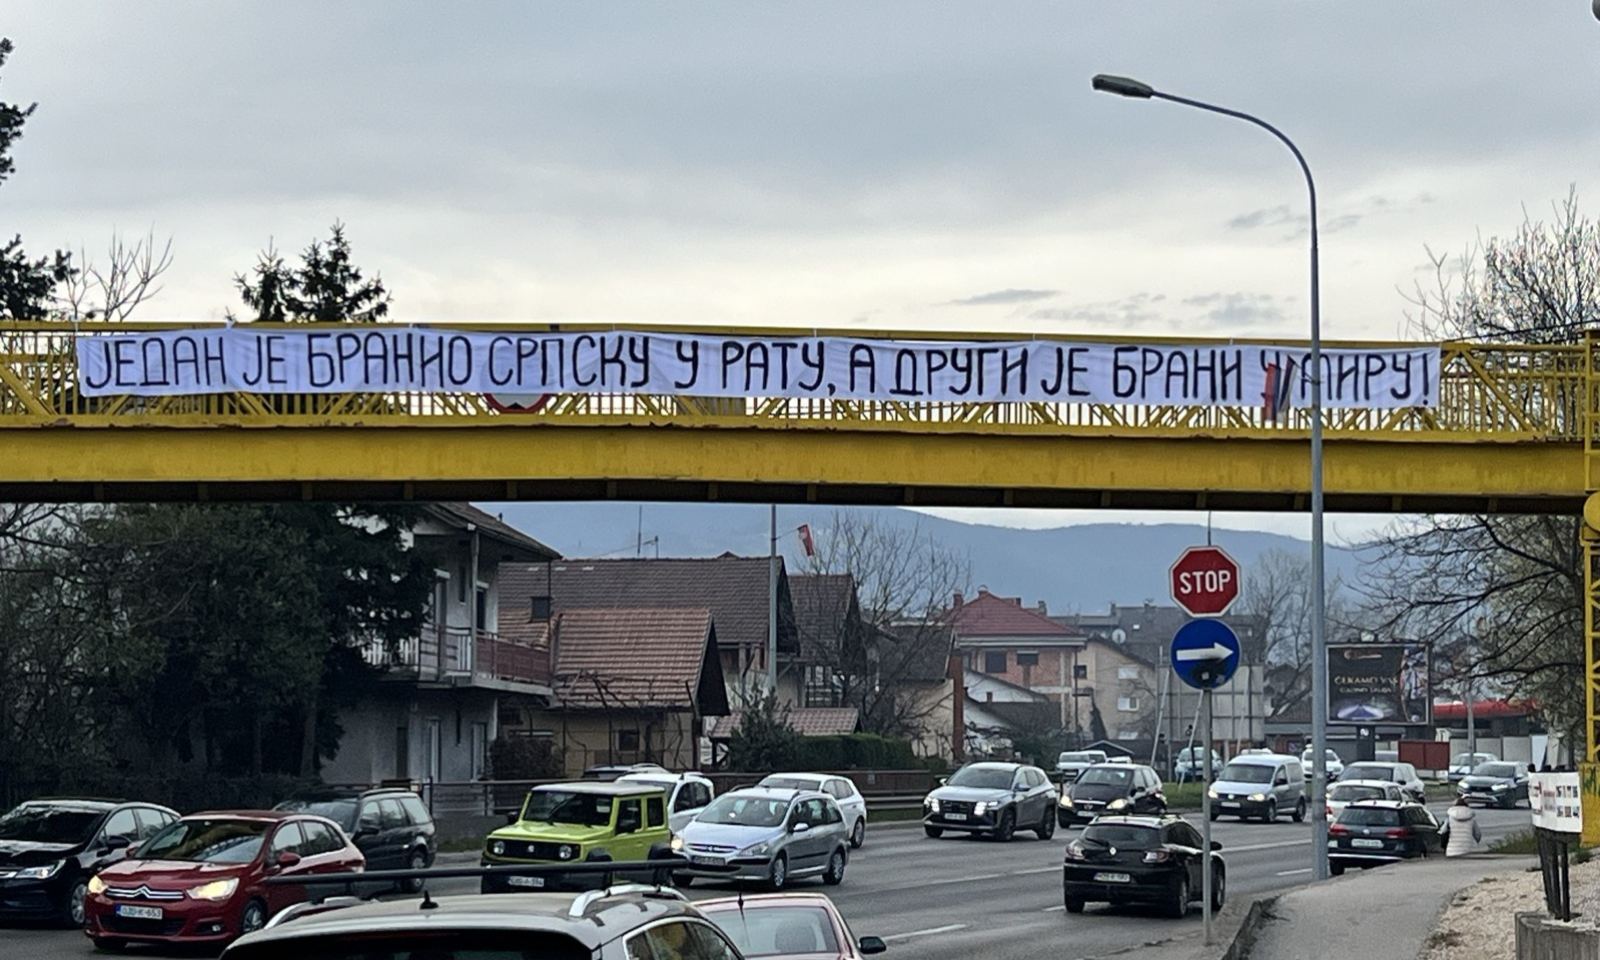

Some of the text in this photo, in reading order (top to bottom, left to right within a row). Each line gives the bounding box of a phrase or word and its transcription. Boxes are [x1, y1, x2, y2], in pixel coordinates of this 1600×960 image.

[85, 335, 227, 389] ЈЕДАН
[242, 335, 287, 386] ЈЕ
[307, 332, 473, 388] БРАНИО
[488, 335, 651, 389] СРПСКУ
[674, 340, 699, 389] У
[720, 340, 837, 397] РАТУ,
[849, 343, 876, 394] А
[889, 347, 1029, 396] ДРУГИ
[1040, 346, 1091, 397] ЈЕ
[1112, 345, 1242, 402] БРАНИ
[1179, 570, 1231, 594] STOP
